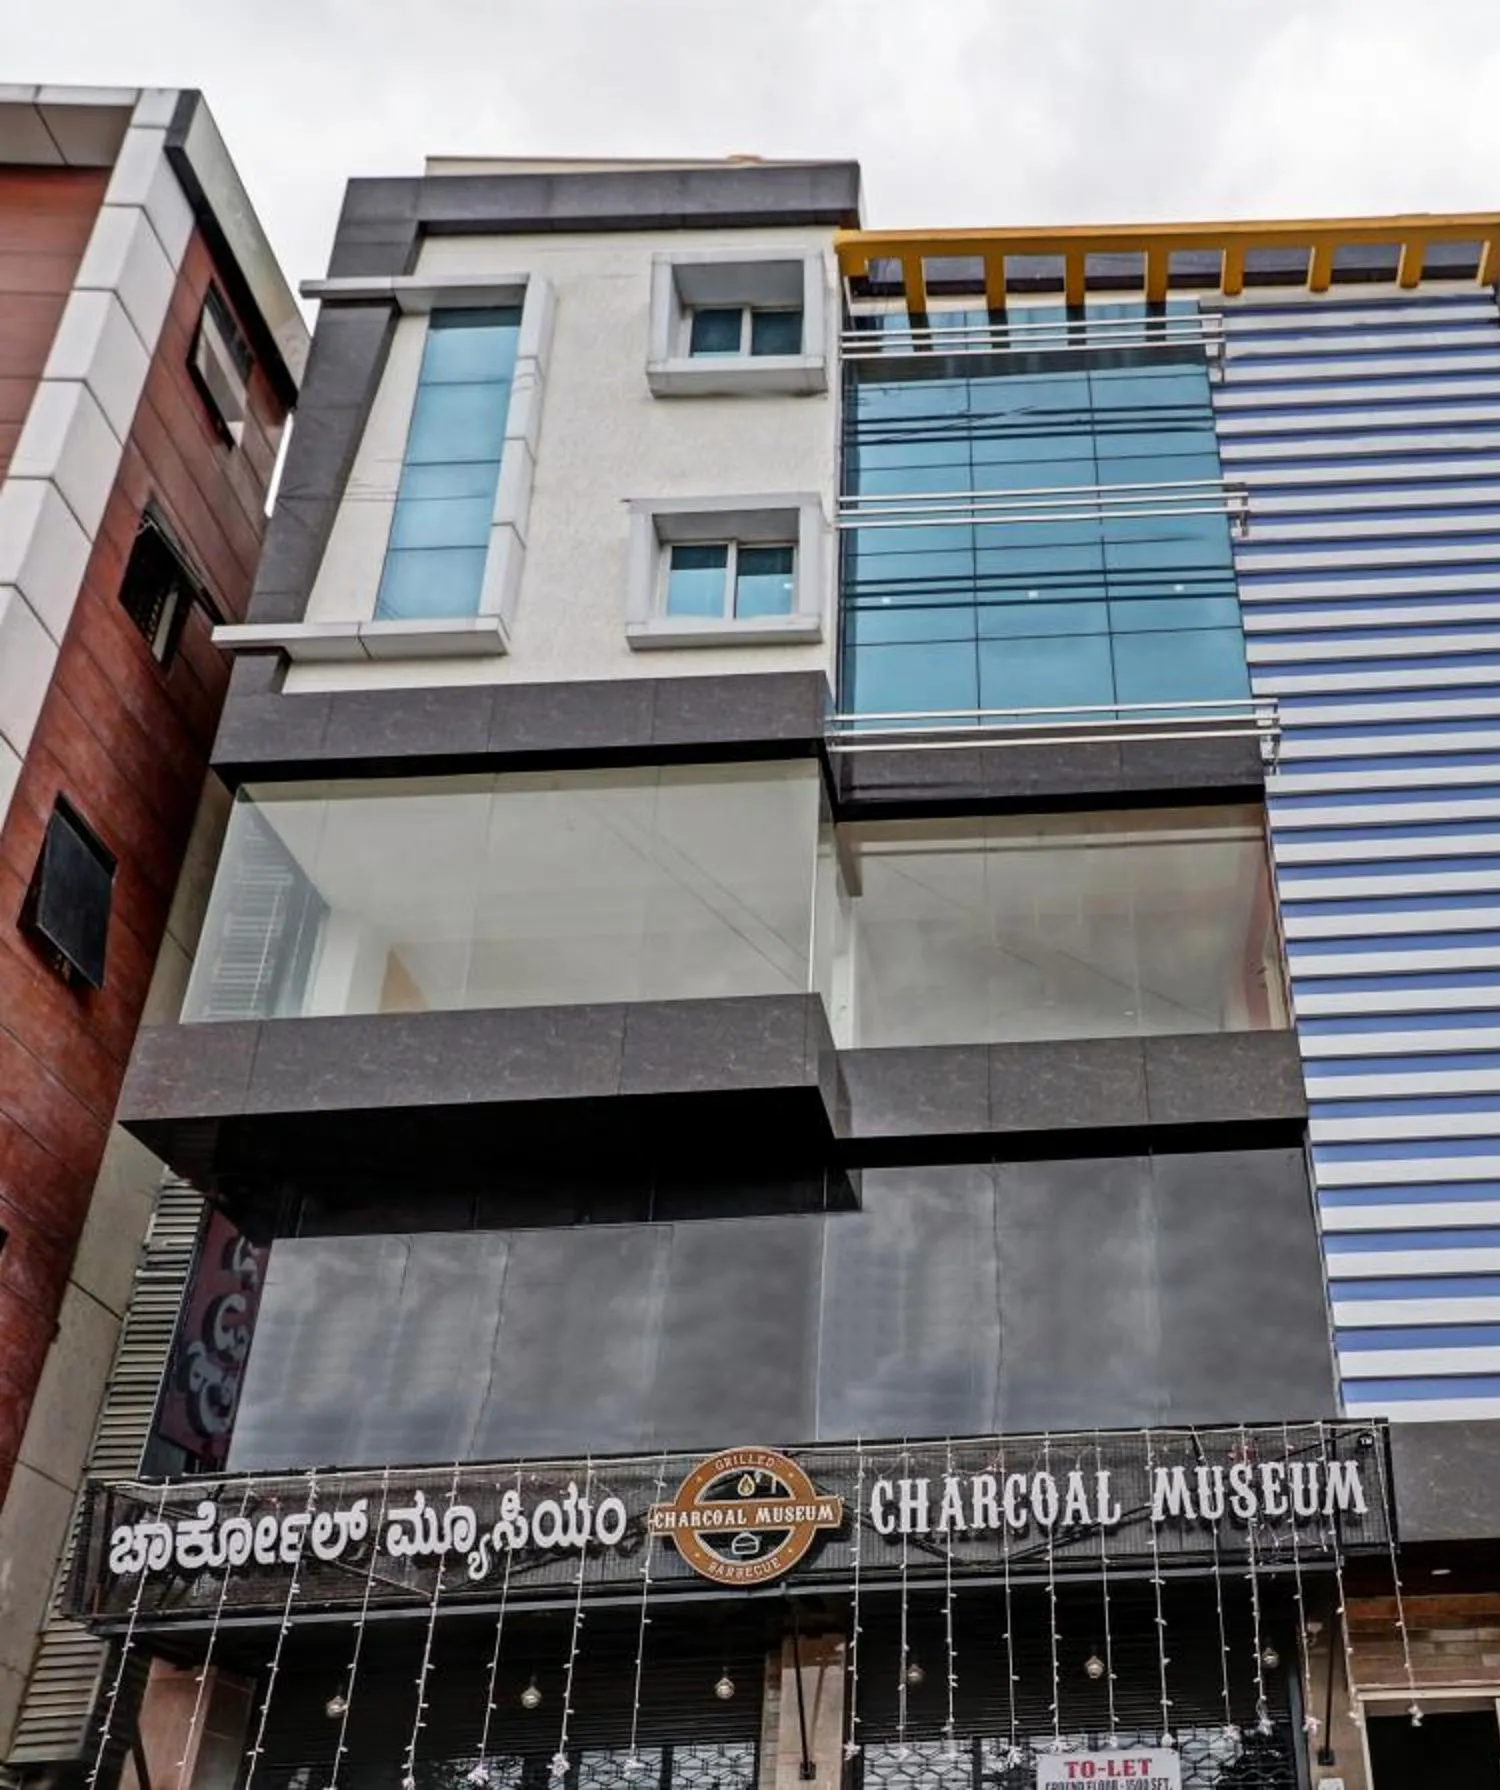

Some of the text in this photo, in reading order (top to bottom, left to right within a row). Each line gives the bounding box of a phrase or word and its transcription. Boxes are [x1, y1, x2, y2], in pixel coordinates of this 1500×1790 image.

[714, 1455, 777, 1471] GRILLED
[870, 1459, 1369, 1535] CHARCOAL MUSEUM
[654, 1504, 835, 1529] CHARCOAL MUSEUM
[109, 1481, 627, 1581] ಚಾರ್ಕೋಲ್ ಮ್ಯೂಸಿಯಂ
[706, 1556, 783, 1579] BARBECUE
[1063, 1758, 1153, 1779] TO-LET
